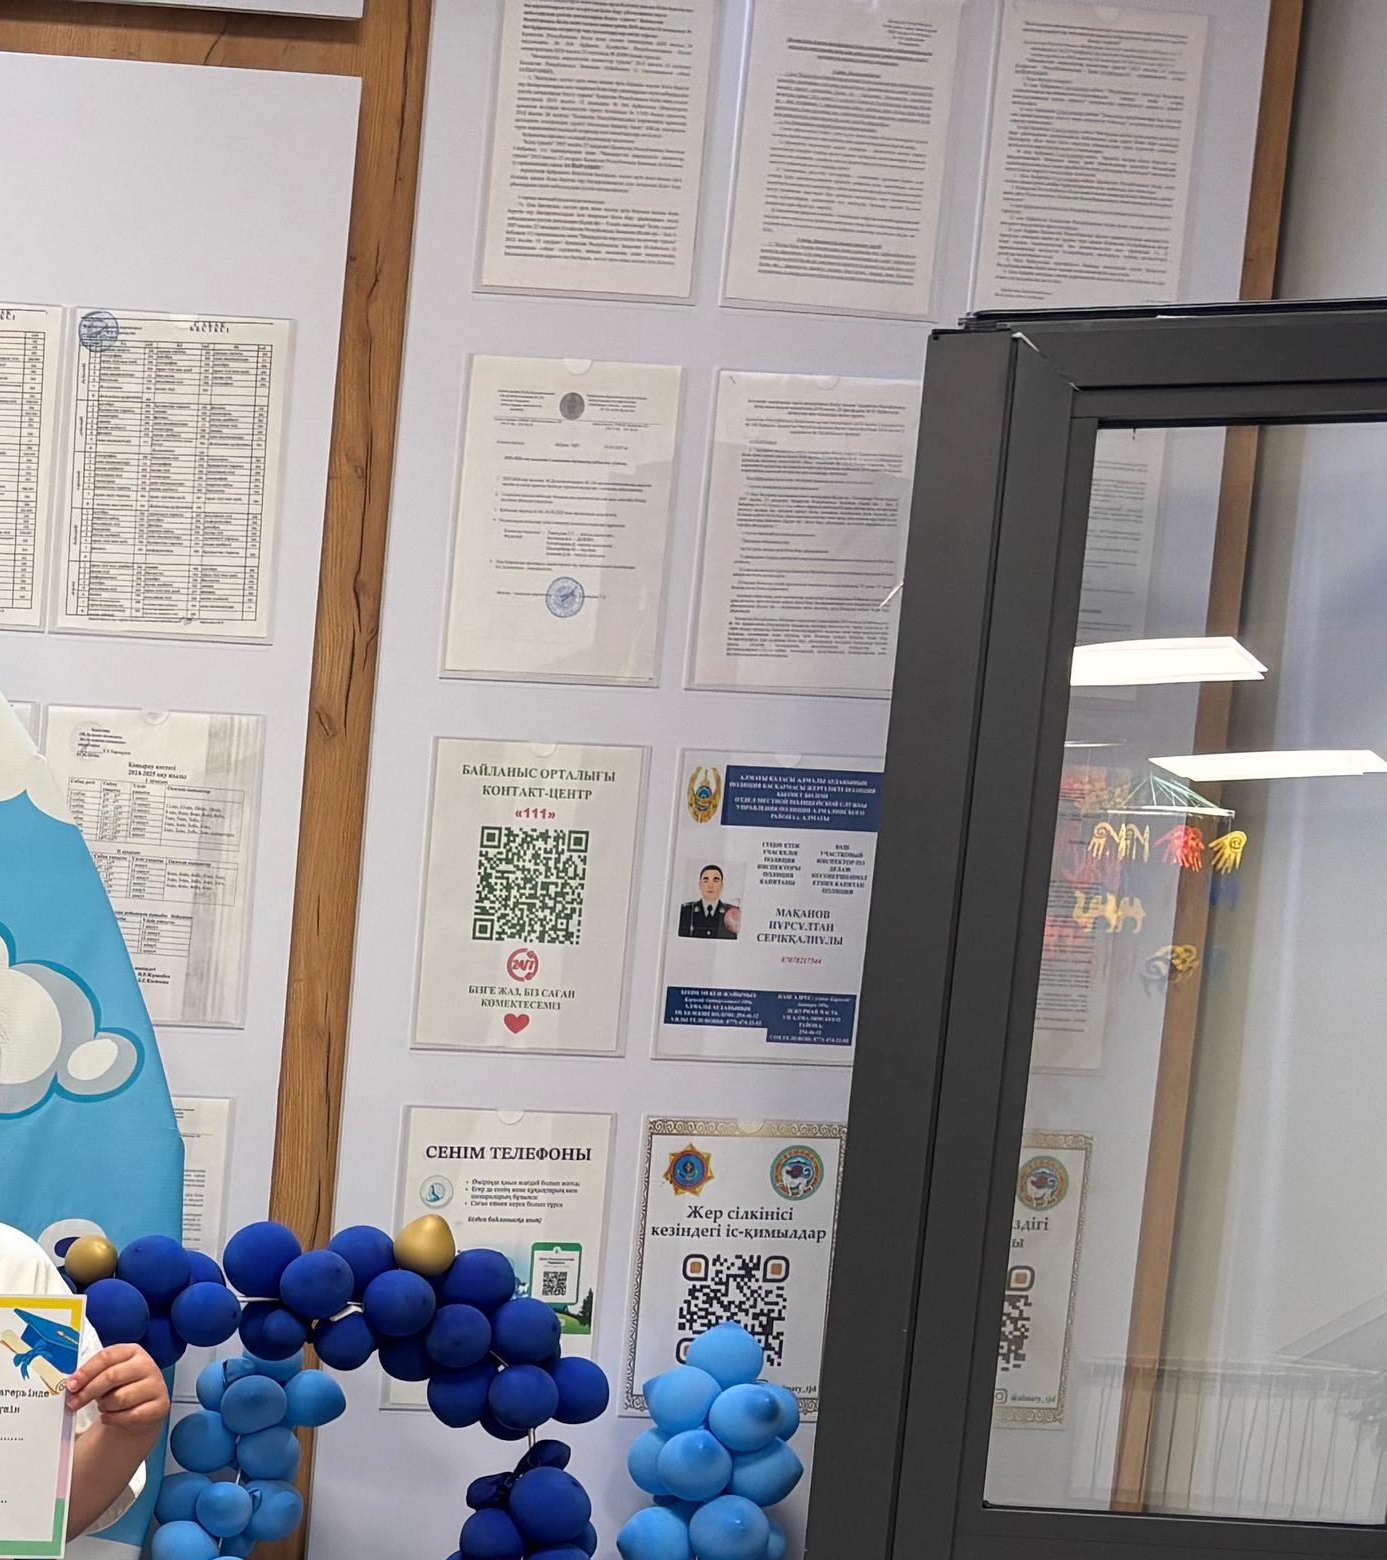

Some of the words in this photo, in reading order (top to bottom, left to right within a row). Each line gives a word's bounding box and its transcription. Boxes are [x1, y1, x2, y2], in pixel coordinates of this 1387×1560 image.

[462, 763, 539, 779] БАЙЛАНЫС
[482, 784, 593, 800] КОНТАКТ-ЦЕНТР
[775, 907, 831, 919] МАҚАНОВ
[425, 1145, 486, 1160] СЕНІМ
[489, 1146, 592, 1161] ТЕЛЕФОНЫ
[686, 1205, 724, 1224] Жер
[727, 1206, 794, 1221] сілкінісі
[651, 1222, 722, 1239] кезіндегі
[725, 1223, 827, 1243] іс-қимылдар
